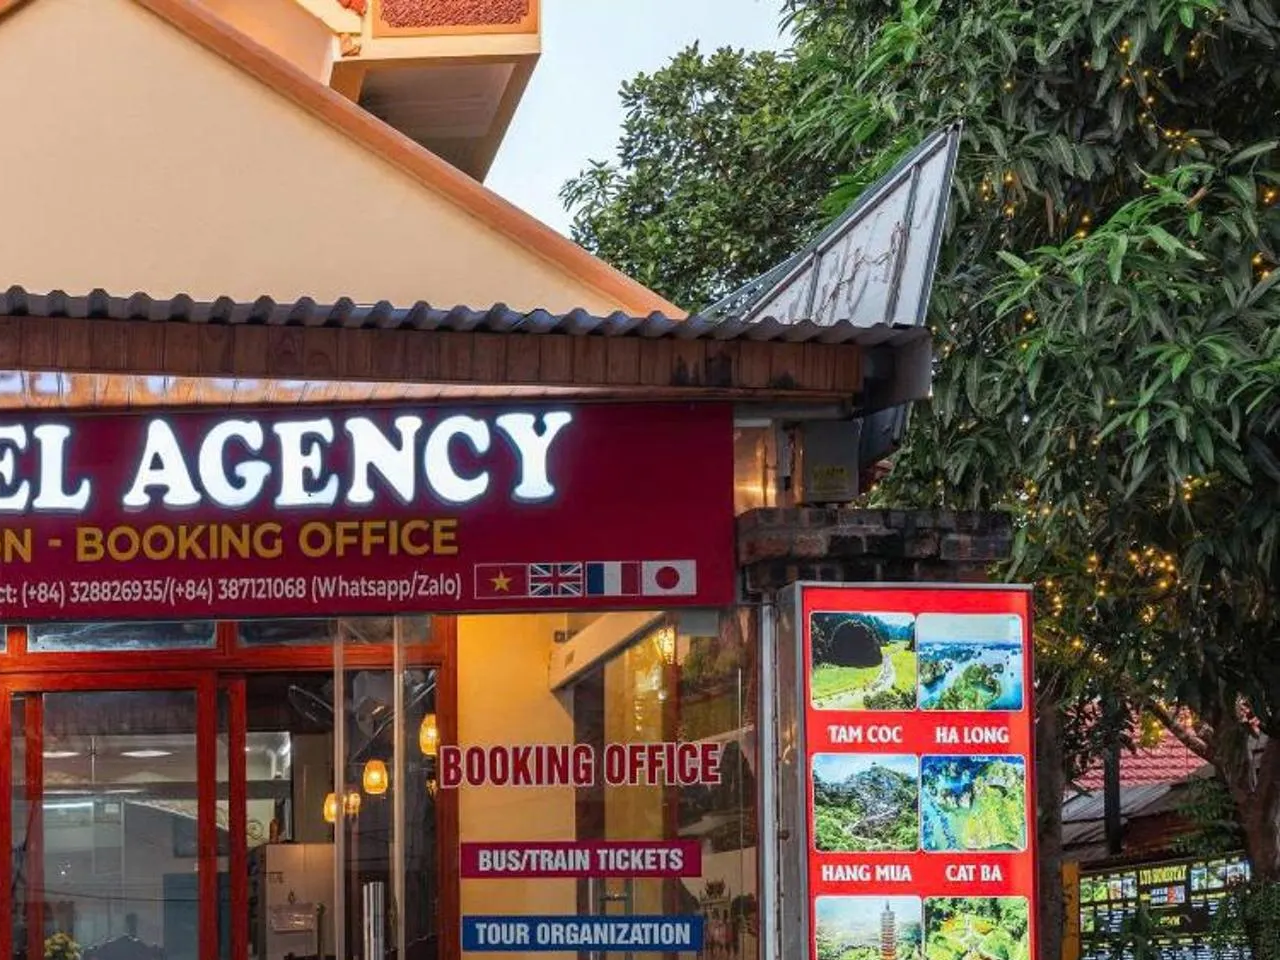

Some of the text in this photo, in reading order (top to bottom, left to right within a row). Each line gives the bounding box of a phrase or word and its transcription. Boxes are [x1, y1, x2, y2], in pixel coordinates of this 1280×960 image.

[121, 409, 573, 508] AGENCY
[77, 524, 283, 563] BOOKING
[298, 519, 458, 558] OFFICE
[22, 580, 65, 608] (+84)
[70, 577, 213, 606] 328826935/(+84)
[218, 577, 307, 600] 387121068
[312, 571, 461, 602] (Whatsapp/Zalo)
[827, 725, 903, 743] TAM COC
[935, 726, 1010, 743] HA LONG
[440, 741, 721, 789] BOOKING OFFICE
[478, 848, 683, 872] BUS/TRAIN TICKETS
[822, 865, 912, 881] HANG MUA
[945, 865, 1003, 881] CAT BA
[475, 922, 690, 944] TOUR ORGANIZATION
